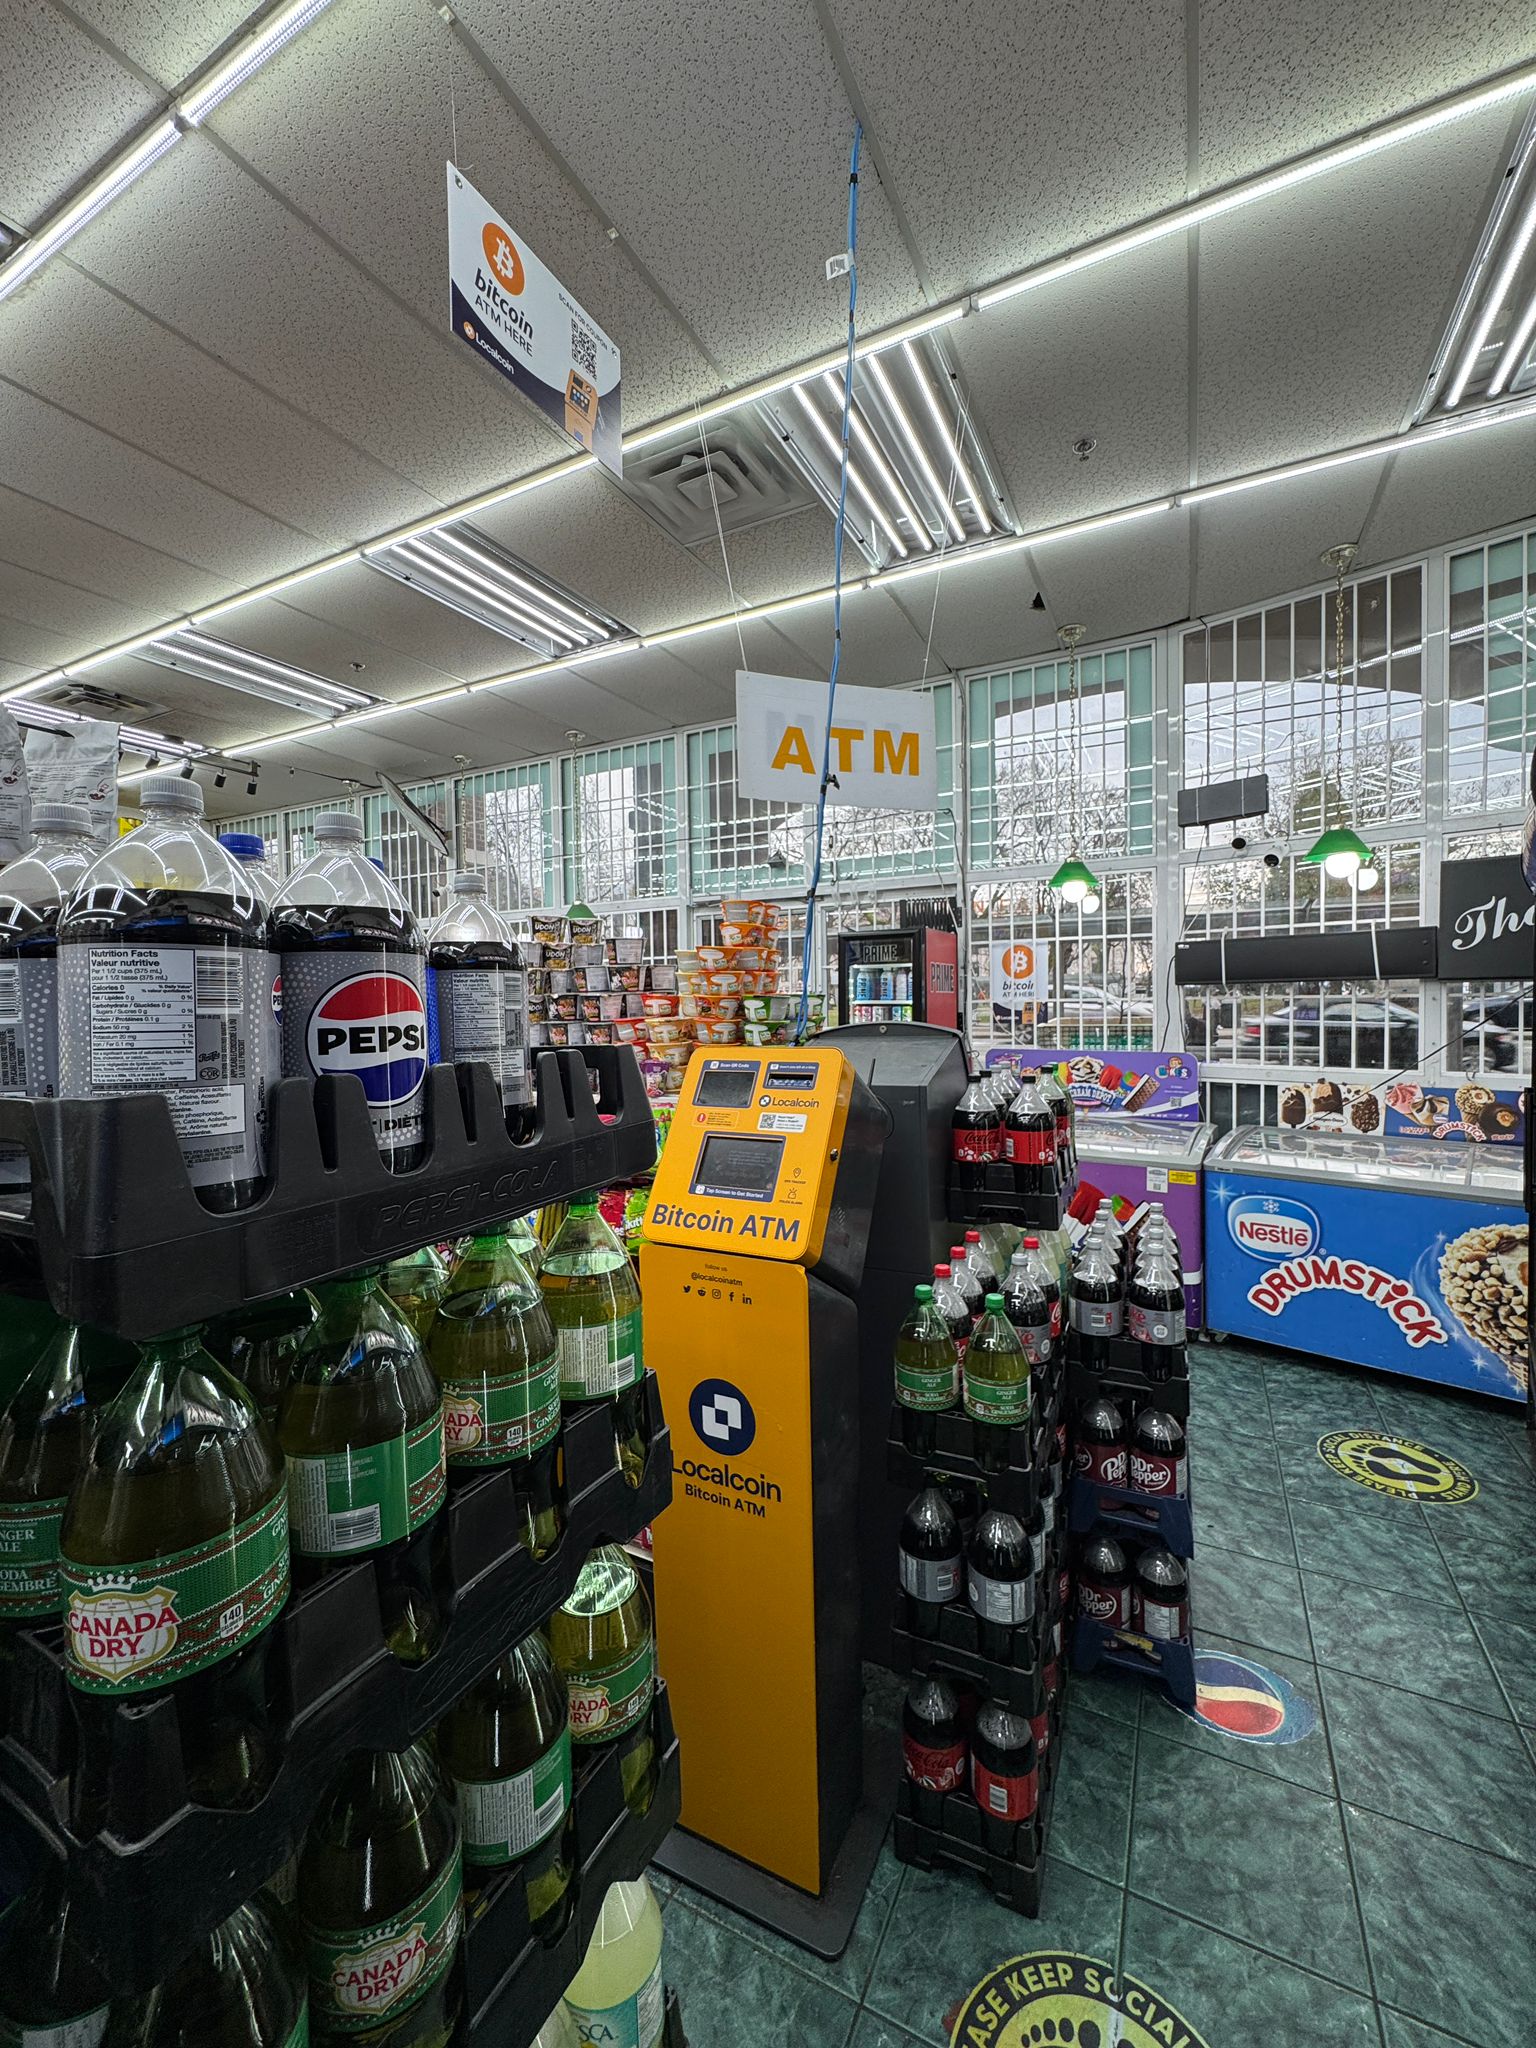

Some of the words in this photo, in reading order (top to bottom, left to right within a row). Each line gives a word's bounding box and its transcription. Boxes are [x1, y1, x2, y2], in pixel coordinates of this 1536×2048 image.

[475, 267, 533, 339] bitcoin
[559, 293, 574, 313] SCAN
[475, 295, 501, 327] ATM
[504, 321, 533, 357] HERE
[476, 332, 515, 375] Localcoin
[770, 726, 920, 776] ATM
[91, 950, 129, 958] Nutrition
[131, 950, 159, 958] Facts
[91, 959, 119, 967] Valeur
[120, 959, 160, 967] nutritive
[863, 944, 898, 962] PRIME
[930, 961, 954, 994] PRIME
[317, 1024, 425, 1056] PEPSI
[772, 1097, 819, 1108] Localcoin
[384, 1114, 424, 1132] DIÈT
[1433, 1121, 1486, 1141] DRUMSTICK
[375, 1160, 557, 1240] PEPSI-COLA
[652, 1203, 734, 1234] Bitcoin
[738, 1214, 800, 1242] ATM
[1239, 1221, 1309, 1247] Nestlé
[691, 1271, 743, 1286] @localcoinatm
[1251, 1260, 1443, 1344] DRUMSTICK
[446, 1412, 484, 1427] ADA
[445, 1427, 463, 1441] RY
[508, 1428, 521, 1437] 140
[1323, 1432, 1350, 1453] SOCIAL
[1349, 1432, 1425, 1451] DISTANCE
[1135, 1458, 1154, 1472] Dr
[1325, 1453, 1353, 1475] KEEP
[1352, 1474, 1419, 1500] PLEASE
[685, 1483, 731, 1508] Bitcoin
[734, 1498, 766, 1518] ATM
[0, 1529, 36, 1541] NGER
[0, 1569, 29, 1580] ODA
[1085, 1587, 1101, 1601] Dr
[69, 1605, 181, 1637] CANADA
[222, 1605, 242, 1625] 140
[88, 1634, 145, 1658] DRY
[570, 1696, 610, 1712] NADA
[572, 1712, 592, 1723] RY
[332, 1936, 427, 1988] CANADA
[357, 1969, 402, 2001] DRY
[962, 1987, 1010, 2048] ASE
[1004, 1961, 1074, 2001] KEEP
